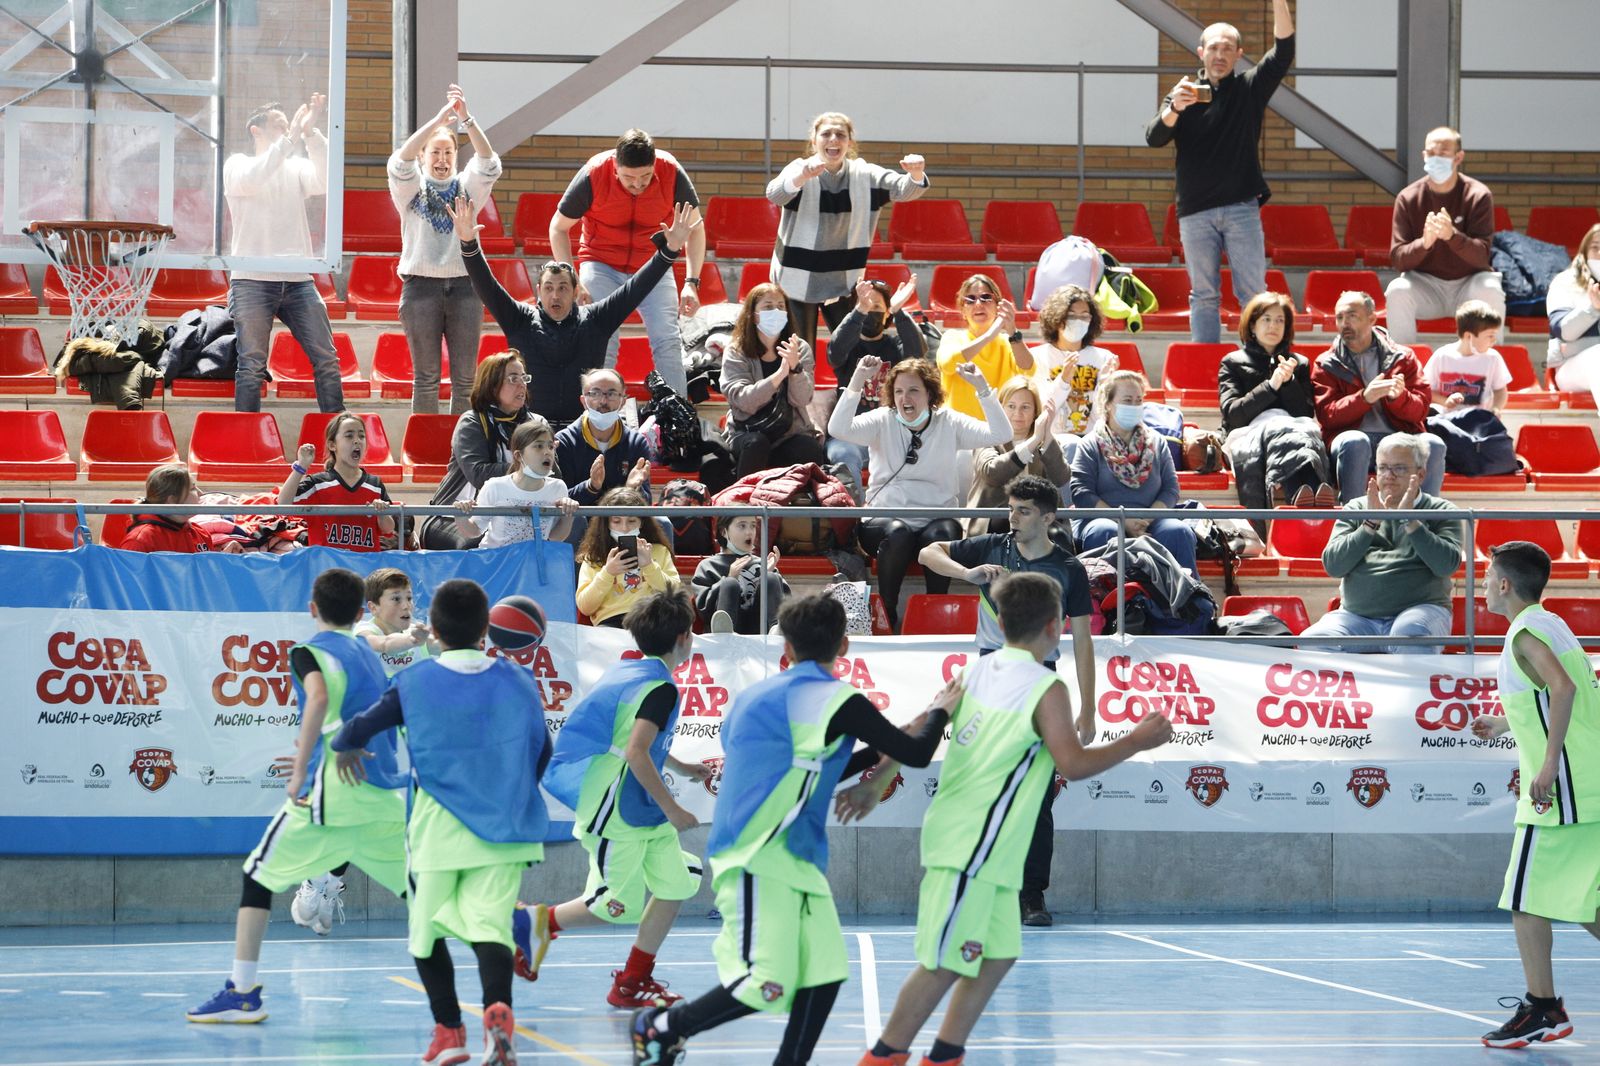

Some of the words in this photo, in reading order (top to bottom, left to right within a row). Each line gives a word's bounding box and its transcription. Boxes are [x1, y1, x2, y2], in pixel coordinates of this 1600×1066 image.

[48, 631, 151, 671] COPA
[222, 634, 297, 672] COP
[36, 669, 168, 705] COVAP
[212, 672, 298, 706] COV
[1107, 655, 1201, 693] COPA
[1265, 663, 1360, 698] COPA
[1430, 674, 1500, 700] COP
[1098, 691, 1216, 725] COVAP
[1256, 696, 1374, 729] COVAP
[1489, 736, 1518, 749] DEPO
[137, 759, 171, 767] COVAP
[1192, 776, 1223, 784] COVAP
[1353, 777, 1384, 785] COVAP
